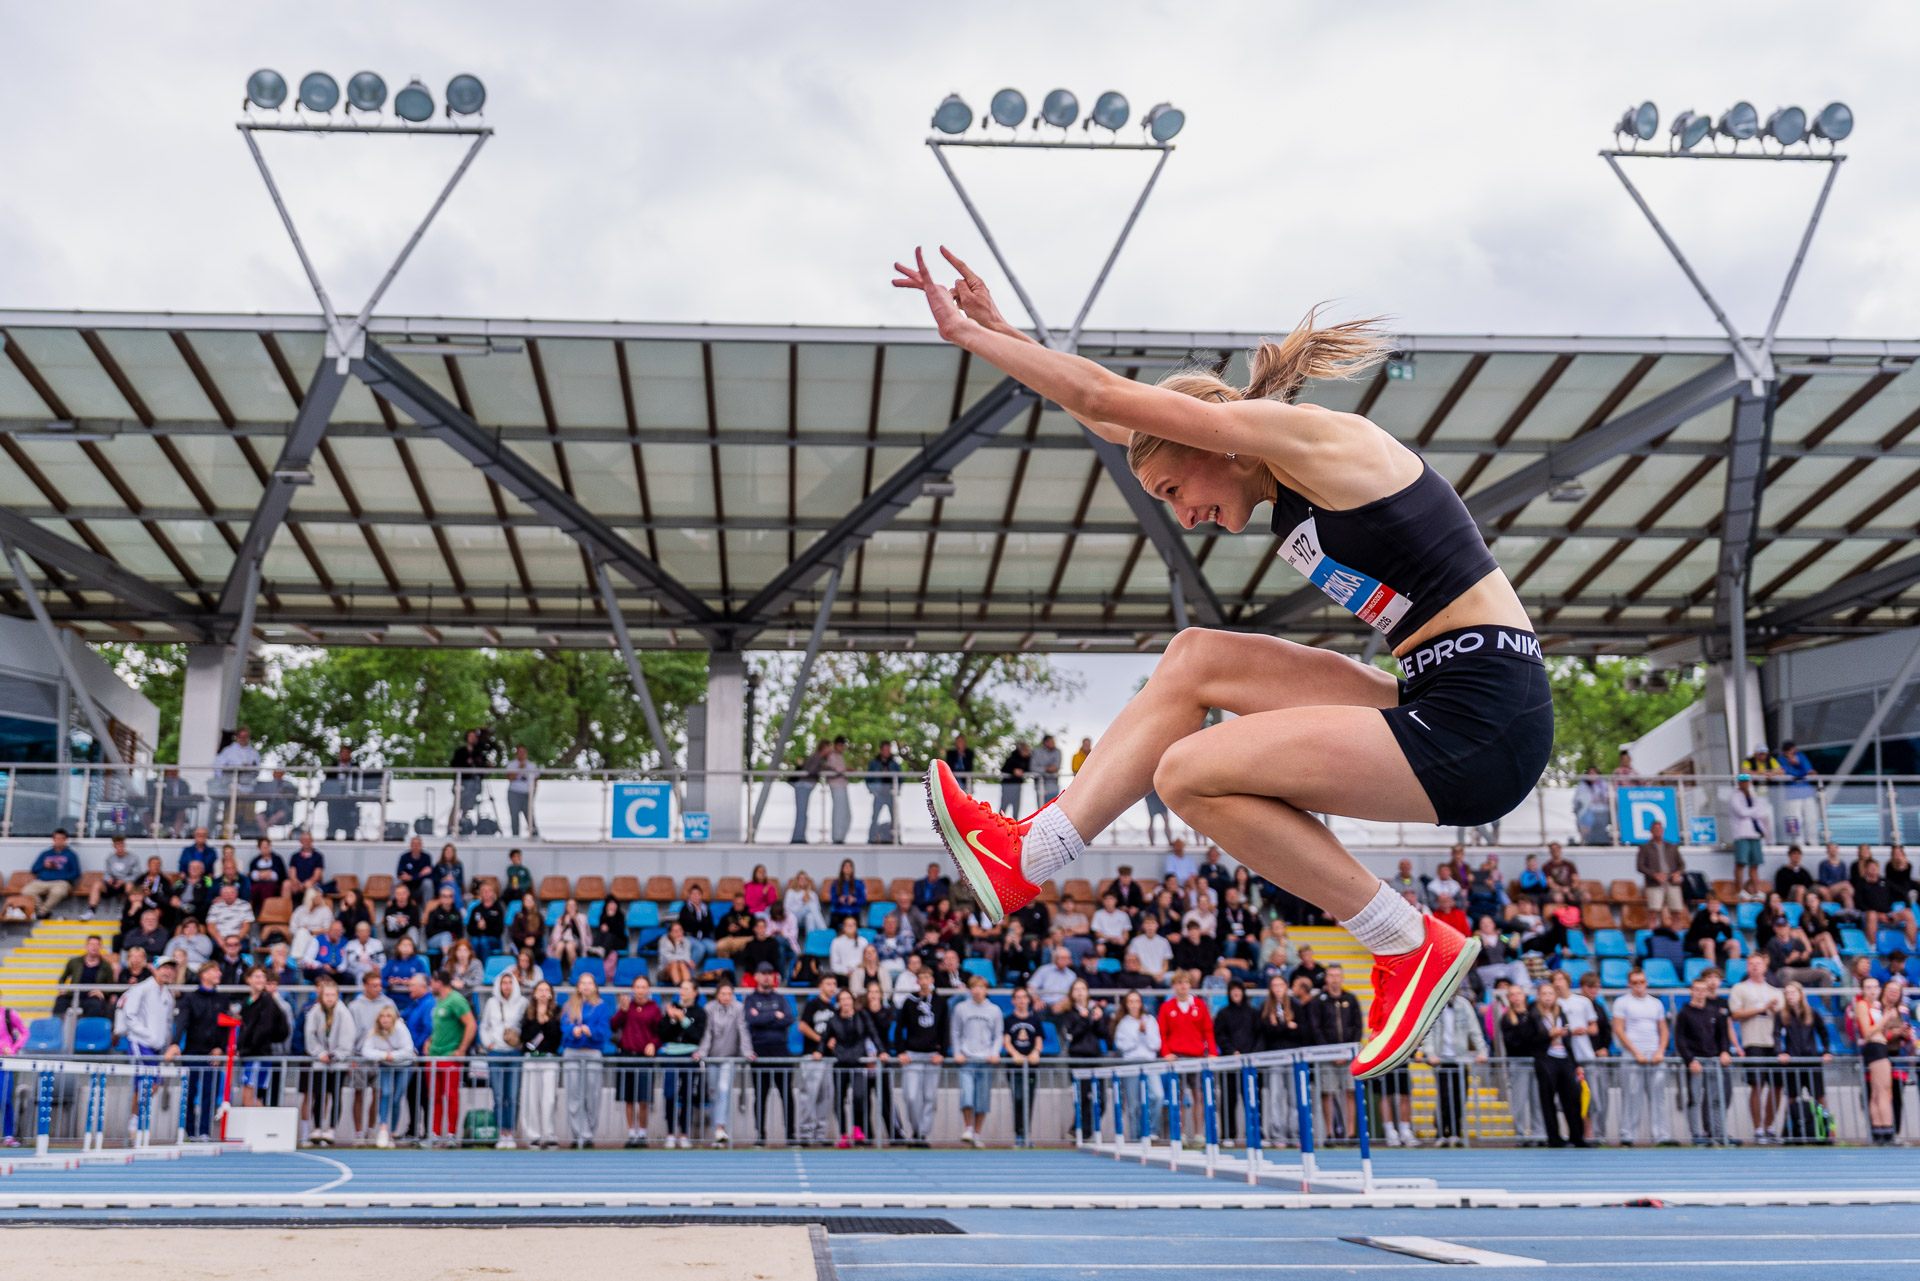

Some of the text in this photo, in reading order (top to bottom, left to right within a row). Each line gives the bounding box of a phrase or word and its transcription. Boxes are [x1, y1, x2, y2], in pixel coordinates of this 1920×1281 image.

[1292, 533, 1317, 565] 972
[1416, 632, 1485, 673] PRO
[625, 797, 657, 836] C
[685, 816, 709, 830] WC
[1631, 801, 1667, 840] D
